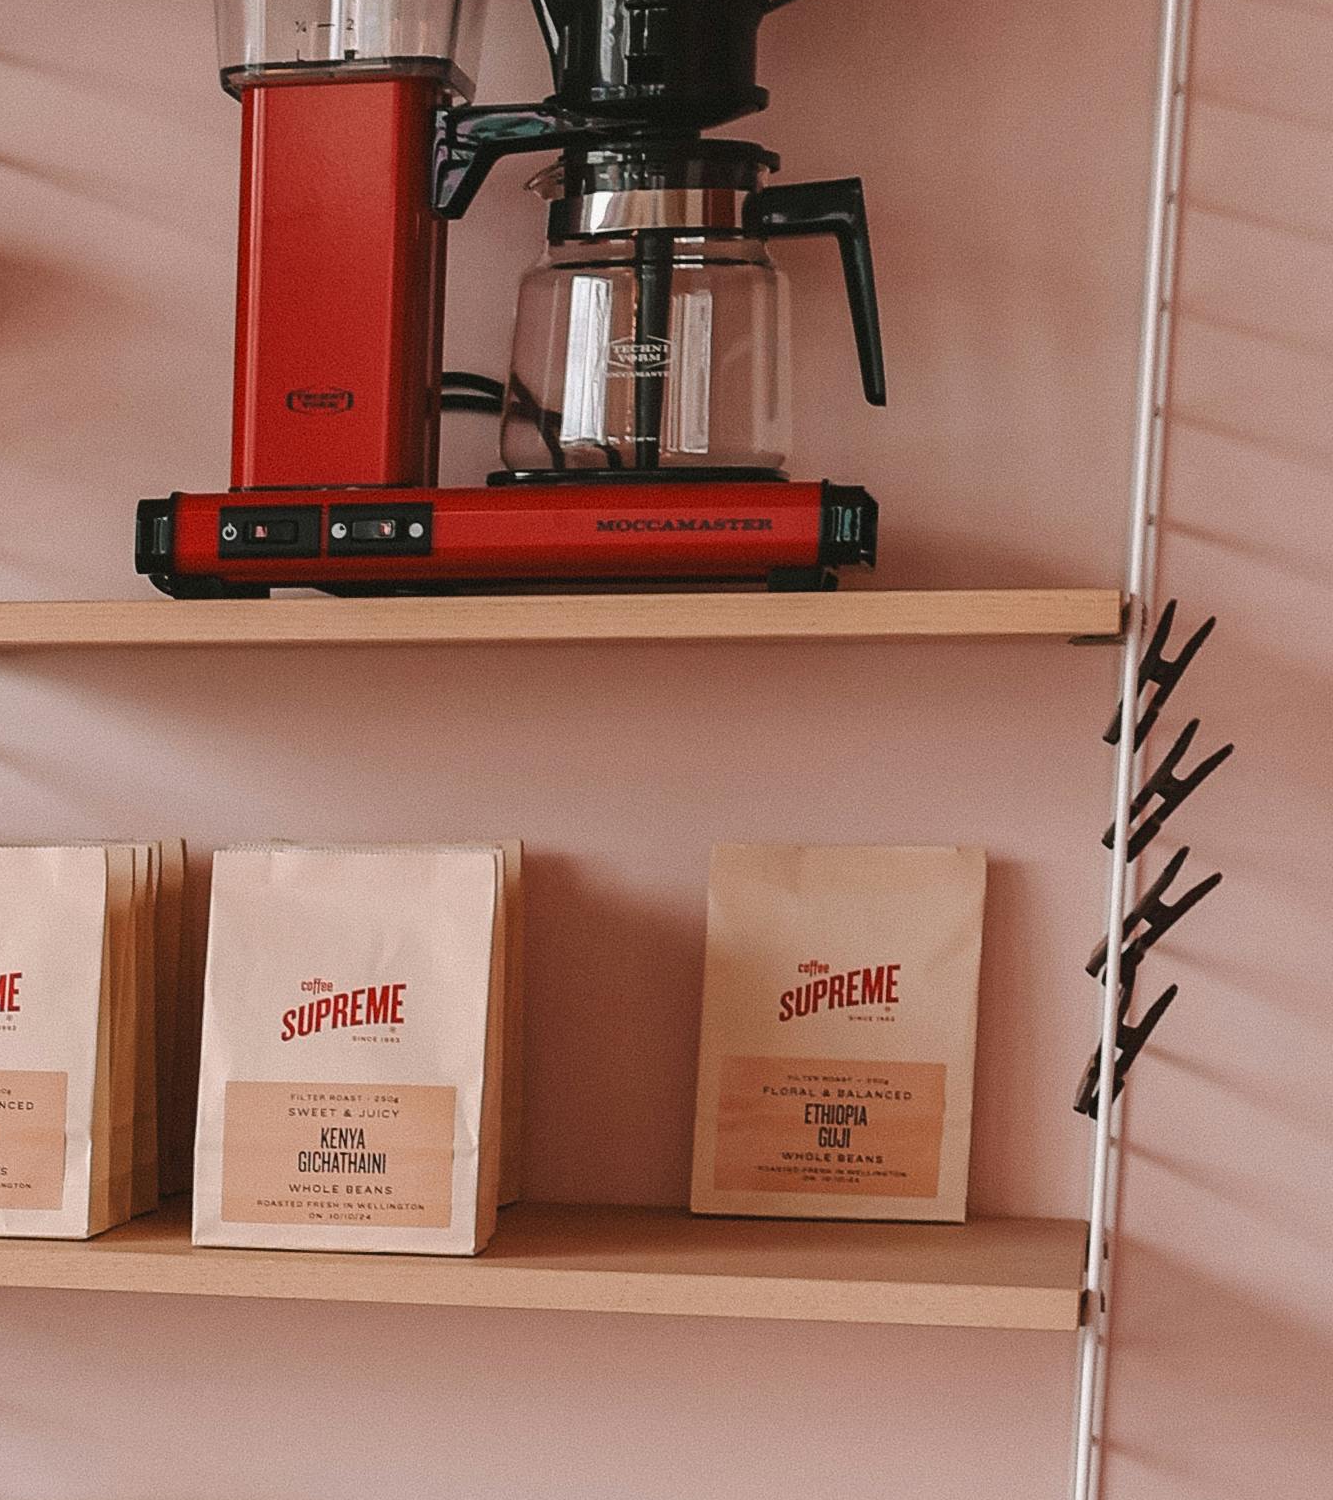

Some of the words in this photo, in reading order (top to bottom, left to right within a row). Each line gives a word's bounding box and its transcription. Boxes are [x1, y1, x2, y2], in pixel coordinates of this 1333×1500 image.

[595, 517, 774, 532] MOCCAMASTER
[797, 959, 831, 978] coffee
[300, 977, 334, 996] coffee
[779, 964, 901, 1023] SUPREME
[280, 983, 407, 1042] SUPREME
[762, 1086, 816, 1098] FLORAL
[836, 1089, 912, 1101] BALANCED
[287, 1107, 338, 1118] SWEET
[343, 1108, 353, 1118] &
[358, 1109, 401, 1119] JUICY
[804, 1102, 868, 1127] ETHIOPIA
[320, 1127, 367, 1150] KENYA
[818, 1127, 852, 1149] GUJI
[297, 1151, 387, 1175] GICHATHAINI
[781, 1151, 833, 1162] WHOLE
[836, 1153, 884, 1165] BEANS
[288, 1183, 340, 1194] WHOLE
[345, 1184, 394, 1196] BEANS
